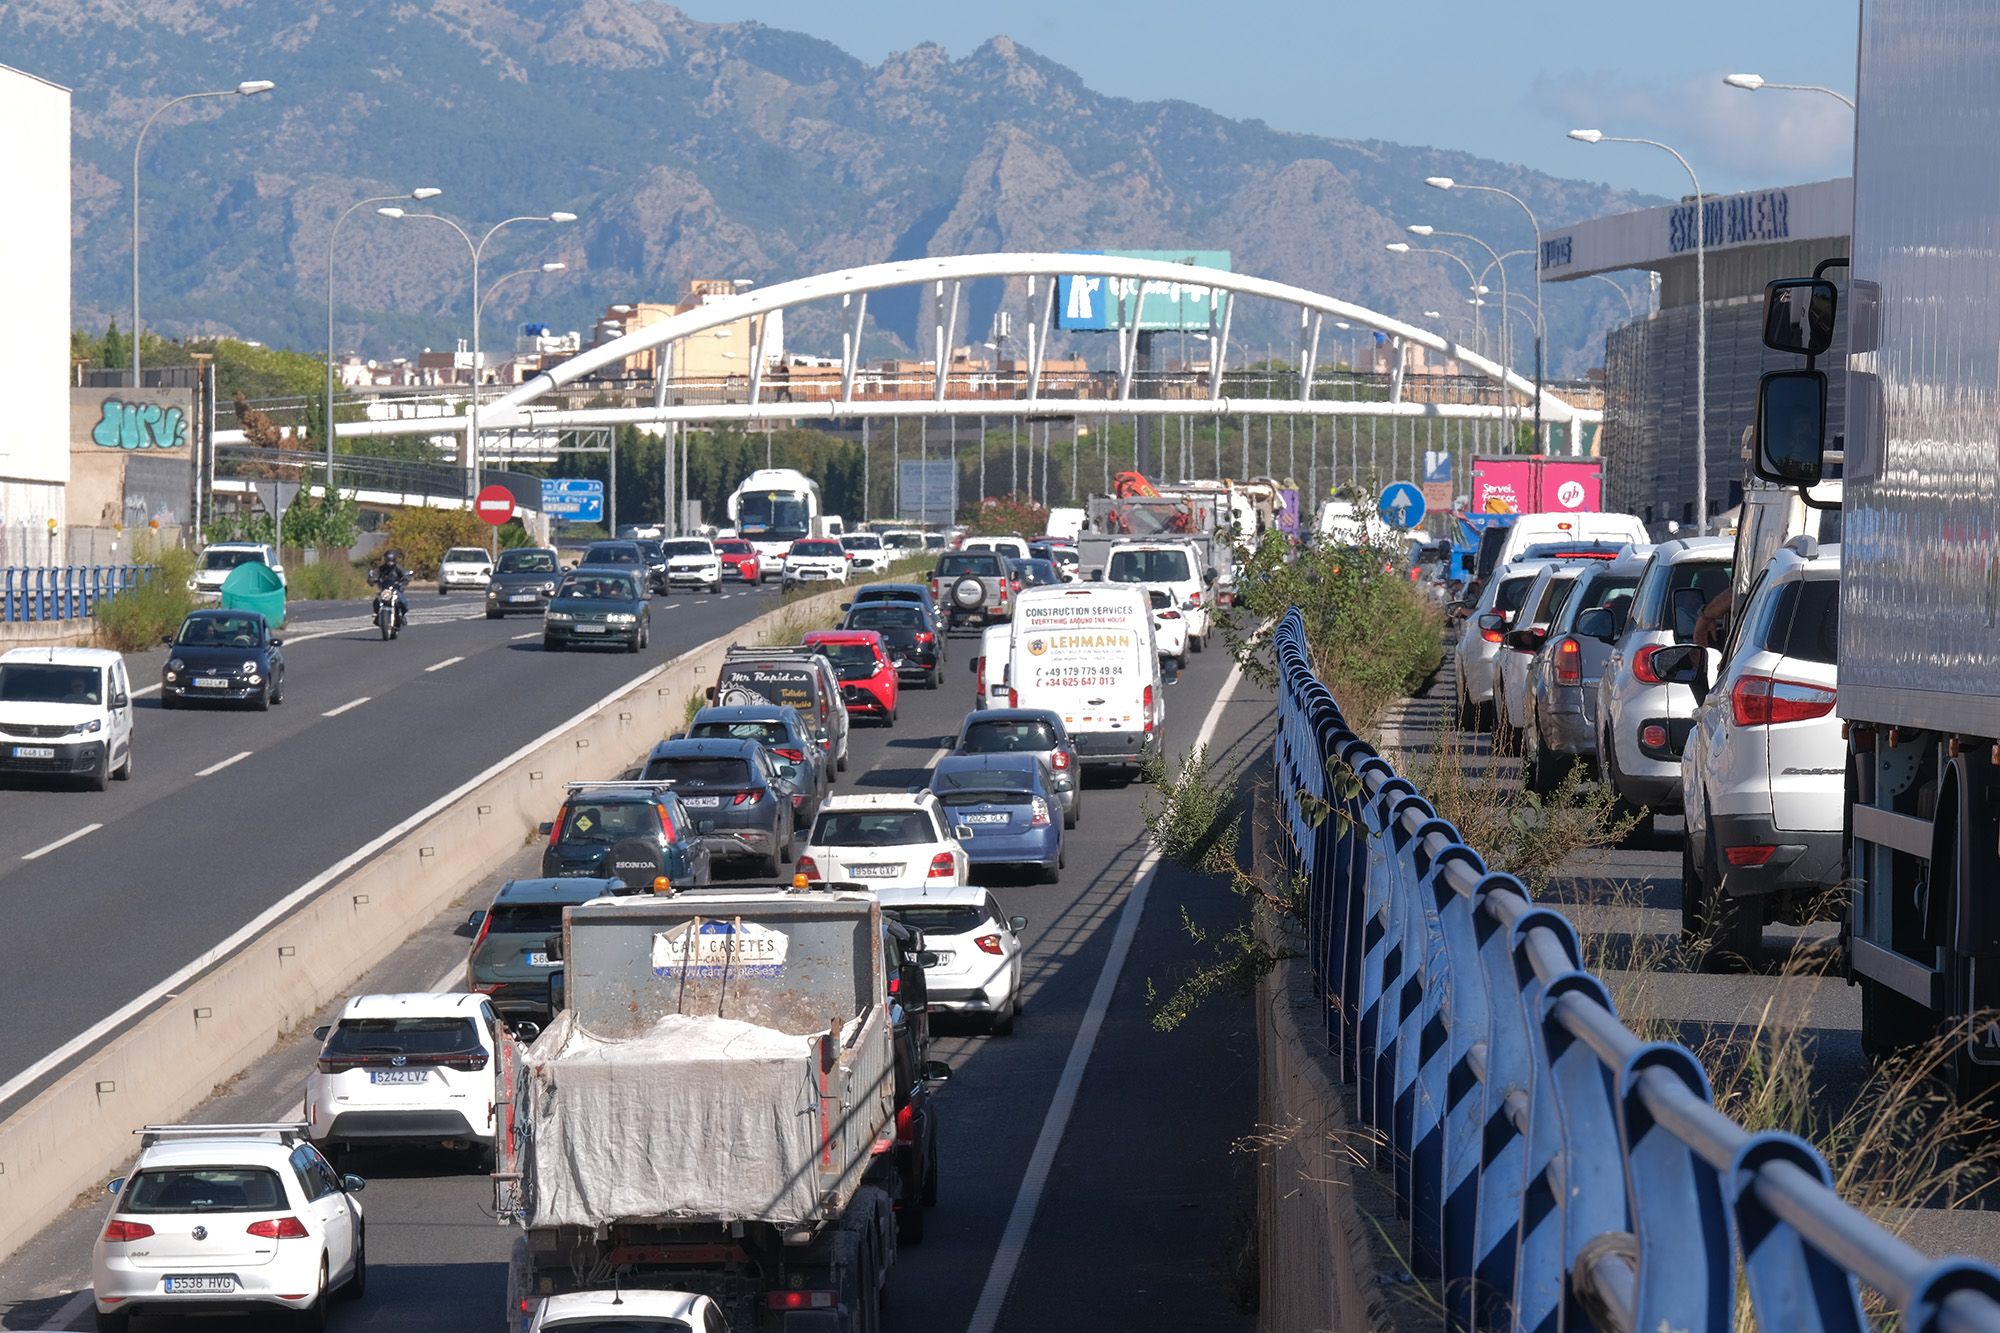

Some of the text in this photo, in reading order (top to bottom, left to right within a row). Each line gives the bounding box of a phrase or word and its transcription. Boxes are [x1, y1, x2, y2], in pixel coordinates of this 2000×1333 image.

[1669, 191, 1788, 253] ESTDIO BALEAR
[1483, 483, 1515, 493] Servei.
[1025, 605, 1133, 617] CONSTRUCTION SERVICES
[1050, 635, 1130, 649] LEHMANN
[1045, 666, 1123, 677] +49 179 775 49 84
[731, 671, 809, 684] Mr Rapid.es
[1045, 676, 1115, 687] +34 625 647 013
[615, 861, 656, 869] HONDA
[856, 866, 896, 875] 9564 GXP
[710, 939, 775, 953] CASETES
[377, 1071, 428, 1082] 5242 LVZ
[174, 1277, 231, 1289] 5538 HVG
